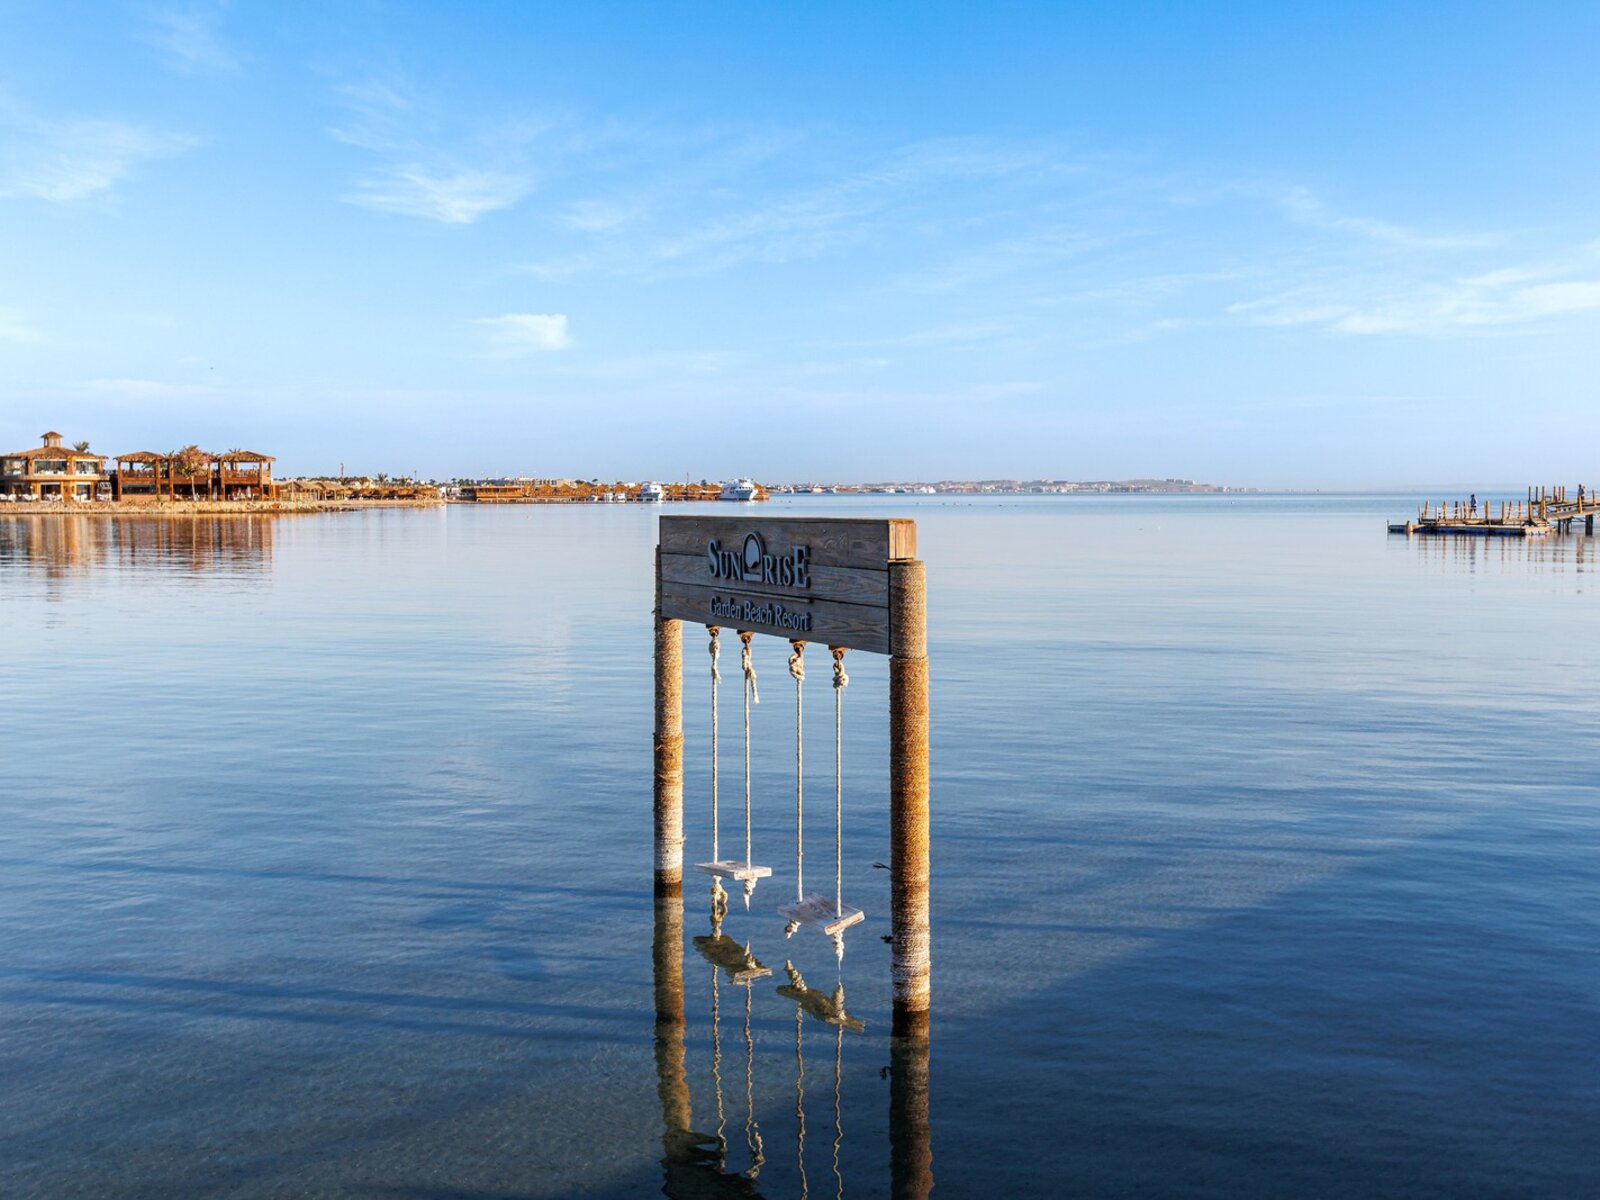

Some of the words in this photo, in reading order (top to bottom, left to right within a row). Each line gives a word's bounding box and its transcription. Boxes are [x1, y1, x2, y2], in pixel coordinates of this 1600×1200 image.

[711, 596, 741, 618] Garden
[743, 600, 773, 624] Beach
[774, 605, 810, 631] Resort
